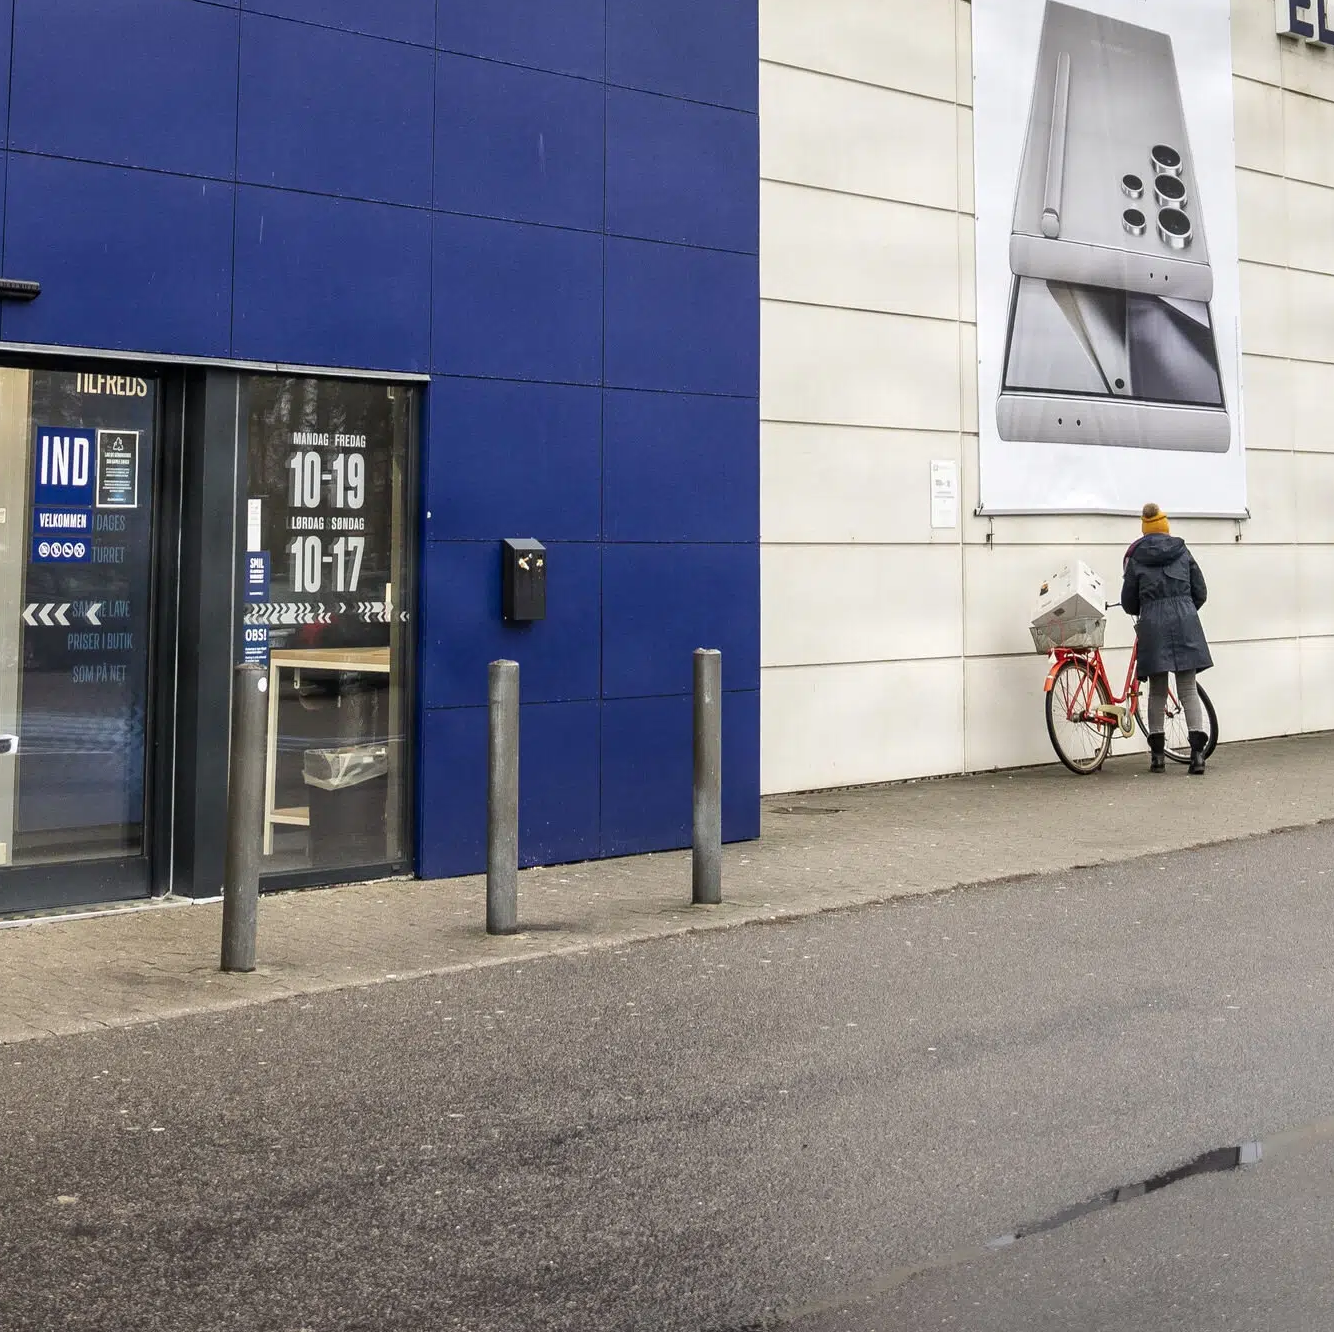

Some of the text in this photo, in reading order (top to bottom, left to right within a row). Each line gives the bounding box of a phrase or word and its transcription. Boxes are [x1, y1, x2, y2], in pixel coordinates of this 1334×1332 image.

[75, 372, 148, 398] TILFREDS
[293, 431, 366, 448] MANDAG FREDAG
[40, 435, 90, 487] IND
[290, 451, 365, 509] 10-19
[39, 513, 87, 529] VELKOMMEN
[96, 515, 126, 531] DAGES
[291, 516, 365, 531] LØRDAG SØNDAG
[91, 546, 125, 563] TURRET
[290, 535, 365, 593] 10-17
[109, 600, 131, 618] LAVE
[68, 633, 99, 651] PRISER
[107, 633, 134, 650] BUTIK
[245, 628, 267, 642] OBS!
[72, 662, 127, 684] SOM PÅ NET
